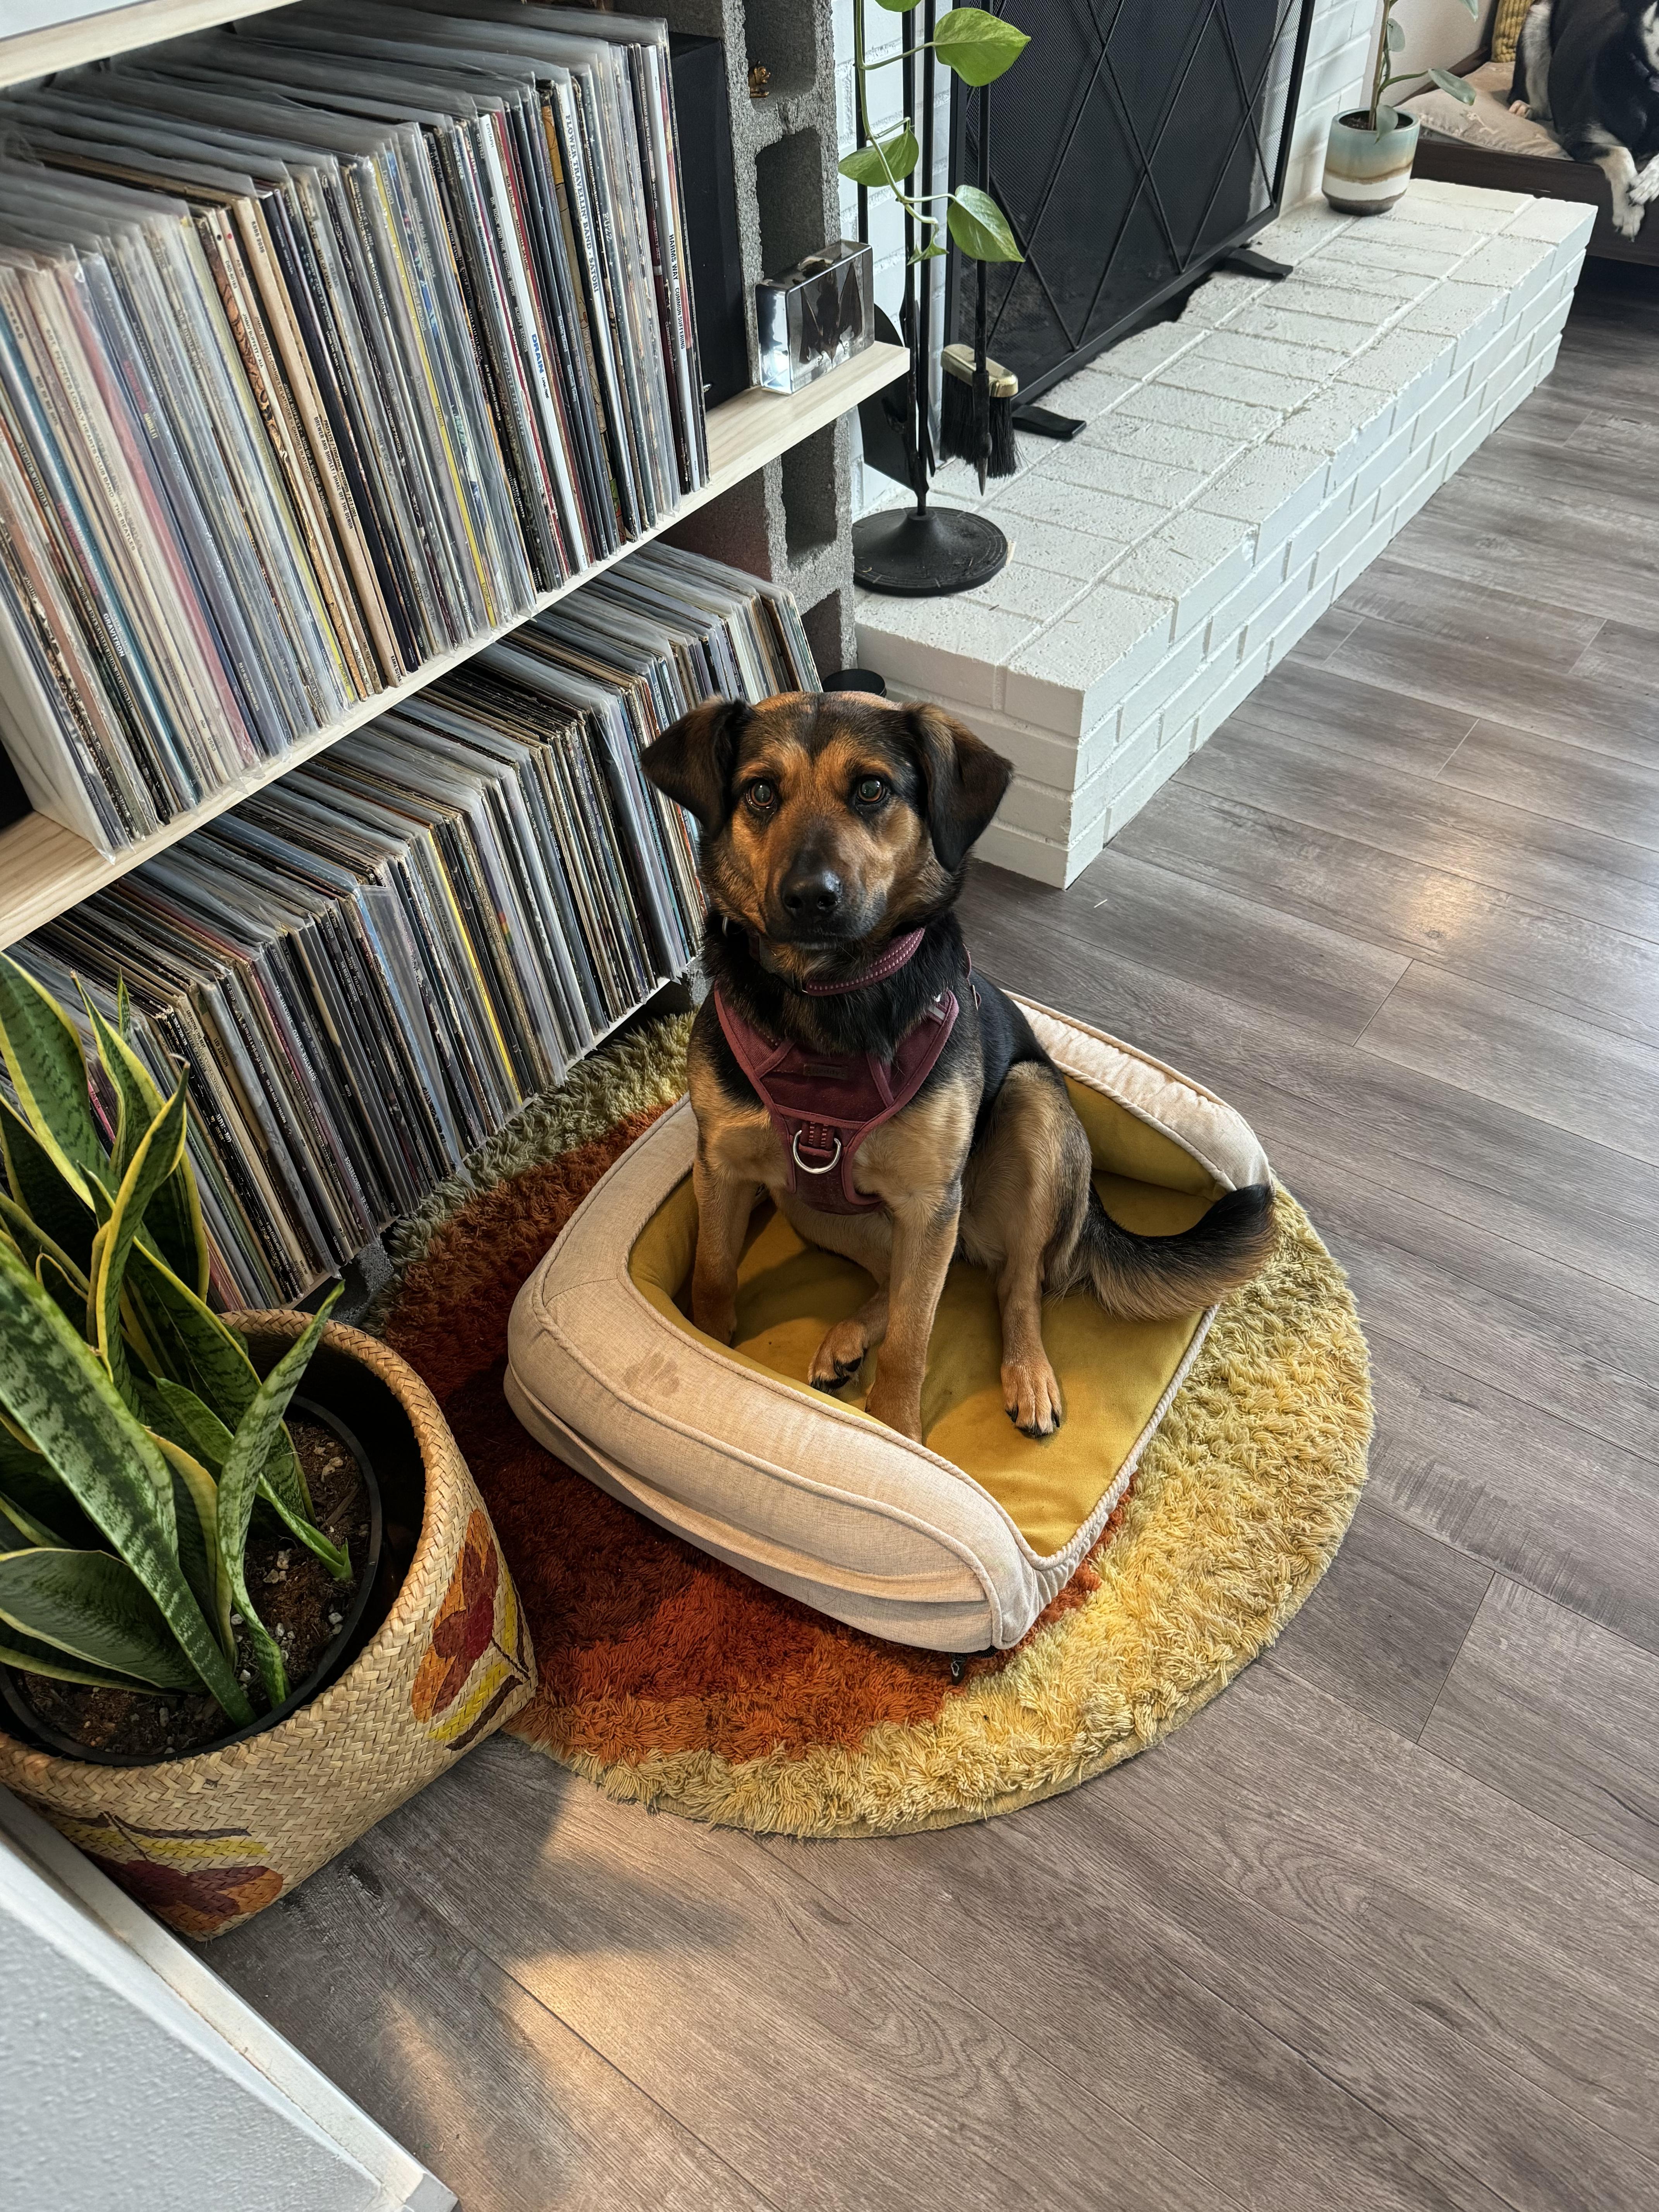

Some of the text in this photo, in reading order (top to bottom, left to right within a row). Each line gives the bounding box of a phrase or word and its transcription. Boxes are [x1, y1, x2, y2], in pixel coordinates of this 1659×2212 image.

[485, 123, 495, 148] EPITAPH
[564, 115, 577, 158] FLOWER
[572, 161, 588, 220] TRAVELLIN'
[582, 222, 593, 250] BAND
[588, 257, 600, 292] SATORI
[413, 198, 422, 222] MACHINE
[427, 256, 437, 278] PURPLE
[601, 213, 613, 242] FUZZ
[668, 234, 677, 262] HARMS
[370, 262, 384, 295] LOOKING
[380, 297, 390, 318] BACK
[491, 208, 500, 225] HOOK
[507, 280, 515, 296] SHOW
[513, 306, 522, 326] SLOPPY
[518, 328, 528, 353] SECONDS
[673, 287, 686, 349] COMMON SUFFERING
[242, 313, 251, 330] JIMMY
[247, 330, 259, 354] BUFFETT
[531, 333, 545, 373] DRAIN
[484, 364, 491, 372] AN
[254, 316, 264, 333] JIMMY
[269, 360, 281, 385] CHANGES
[290, 426, 302, 450] CHANGES
[282, 382, 293, 402] JIMMY
[486, 373, 497, 401] AMERICAN
[289, 403, 303, 431] BUFFETT
[434, 406, 445, 428] DANAVA
[69, 391, 86, 421] LONELY
[82, 422, 98, 454] HEARTS
[94, 454, 106, 475] CLUB
[300, 436, 309, 450] SON
[304, 450, 312, 458] OF
[323, 419, 334, 443] PREFLYTE
[339, 471, 350, 493] RECORDS
[309, 464, 318, 477] SON
[313, 416, 354, 529] BREWER AND SHIPLEY SHAKE OFF THE DEMON
[314, 477, 321, 486] OF
[102, 476, 136, 551] BAND THE BEATLES
[102, 613, 125, 658] GRAVITRON
[389, 655, 403, 682] KAMA SUTRA
[656, 697, 666, 719] SWORD
[206, 736, 217, 752] 2653
[189, 1017, 198, 1031] KOTTKE
[242, 1023, 250, 1035] ALVIN
[213, 1038, 230, 1067] LED ZEPPELIN
[301, 1052, 317, 1082] BULLHEAD
